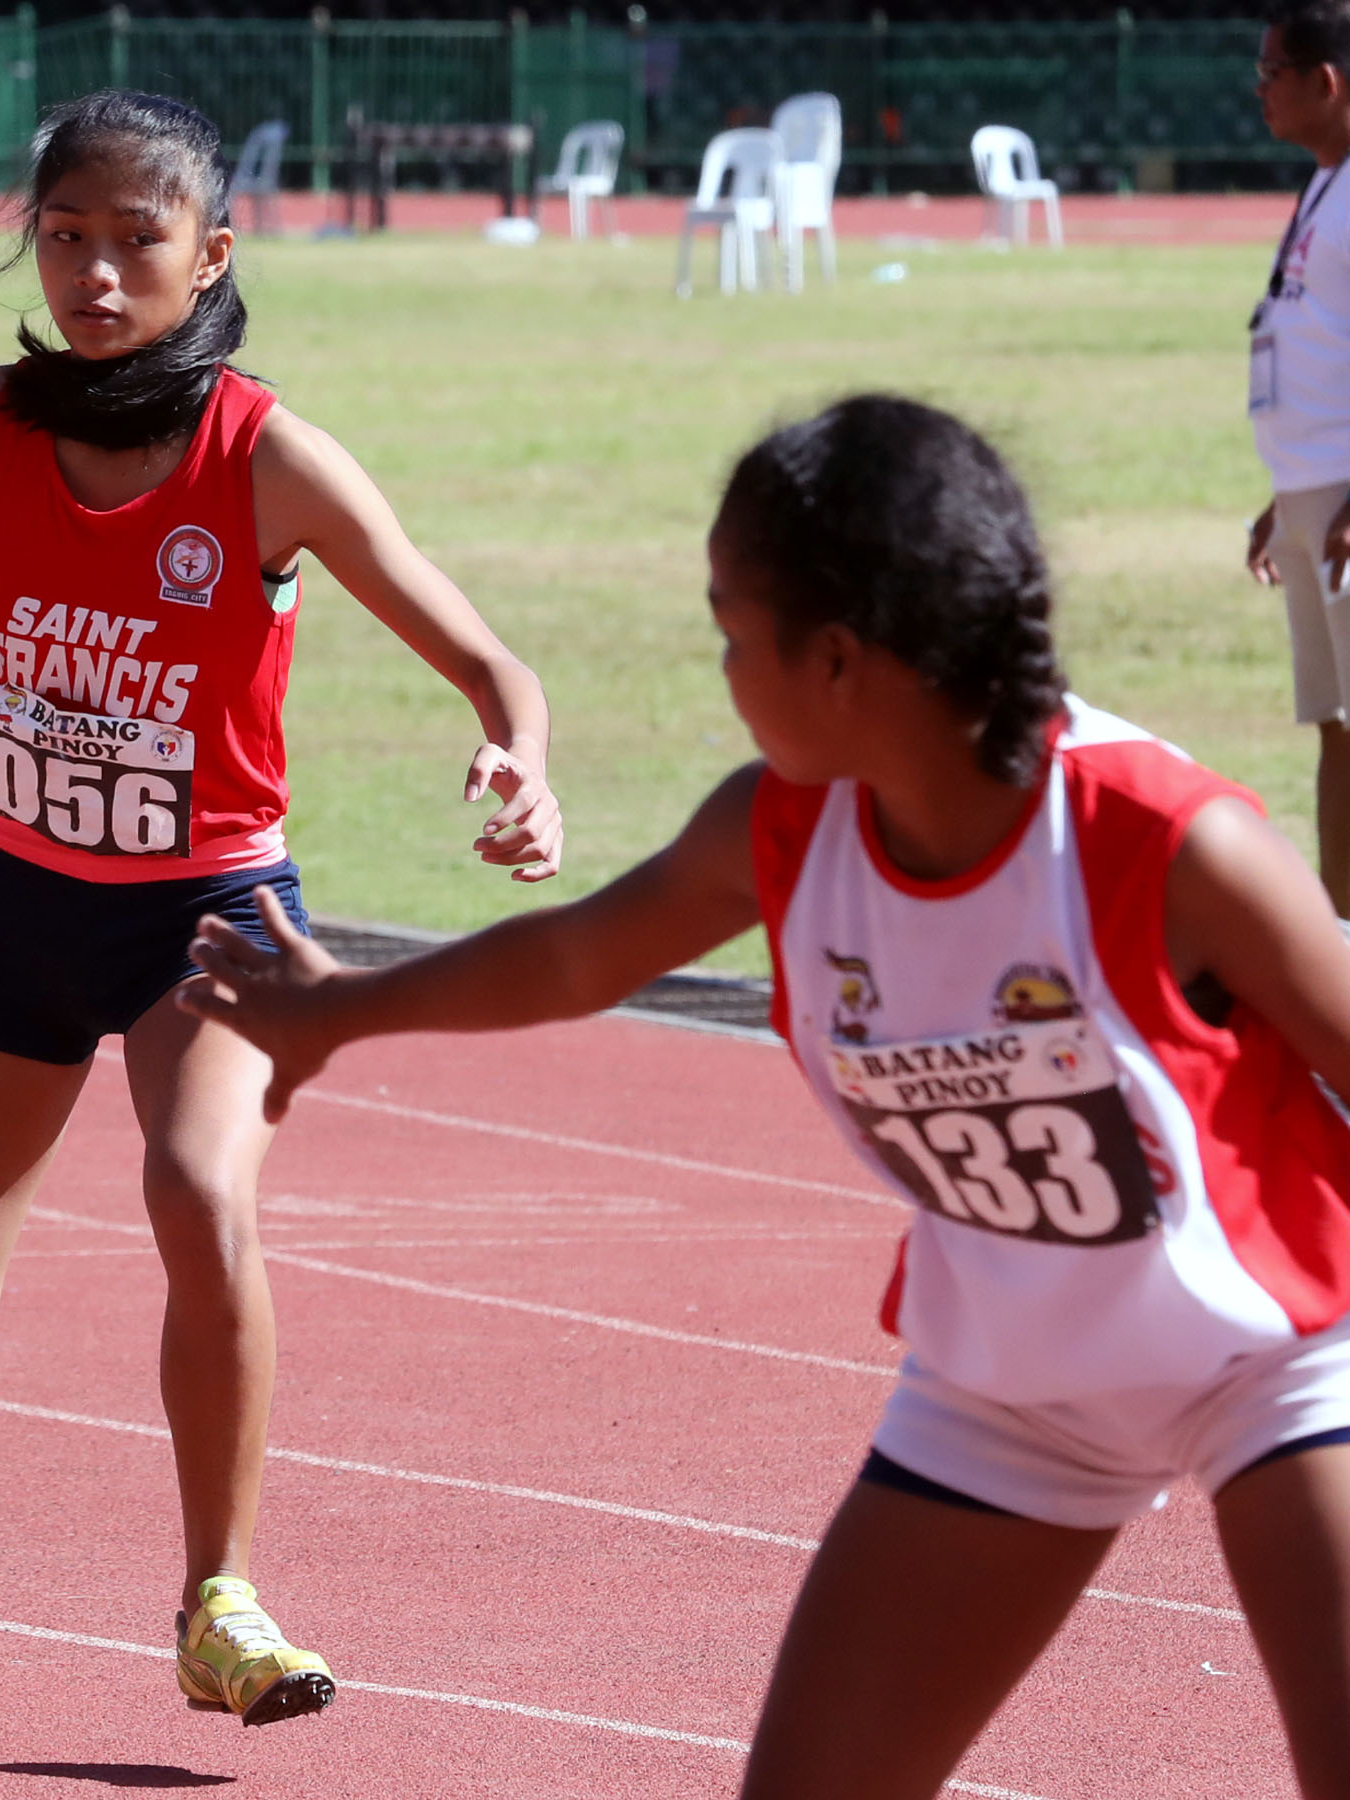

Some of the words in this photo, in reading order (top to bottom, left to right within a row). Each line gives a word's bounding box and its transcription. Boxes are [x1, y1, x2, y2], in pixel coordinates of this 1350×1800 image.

[190, 594, 207, 603] CITY
[7, 596, 158, 655] SAINT
[29, 700, 141, 742] BATANG
[34, 729, 124, 761] PINOY
[860, 1034, 1024, 1078] BATANG
[894, 1071, 1014, 1105] PINOY
[872, 1105, 1122, 1237] 133
